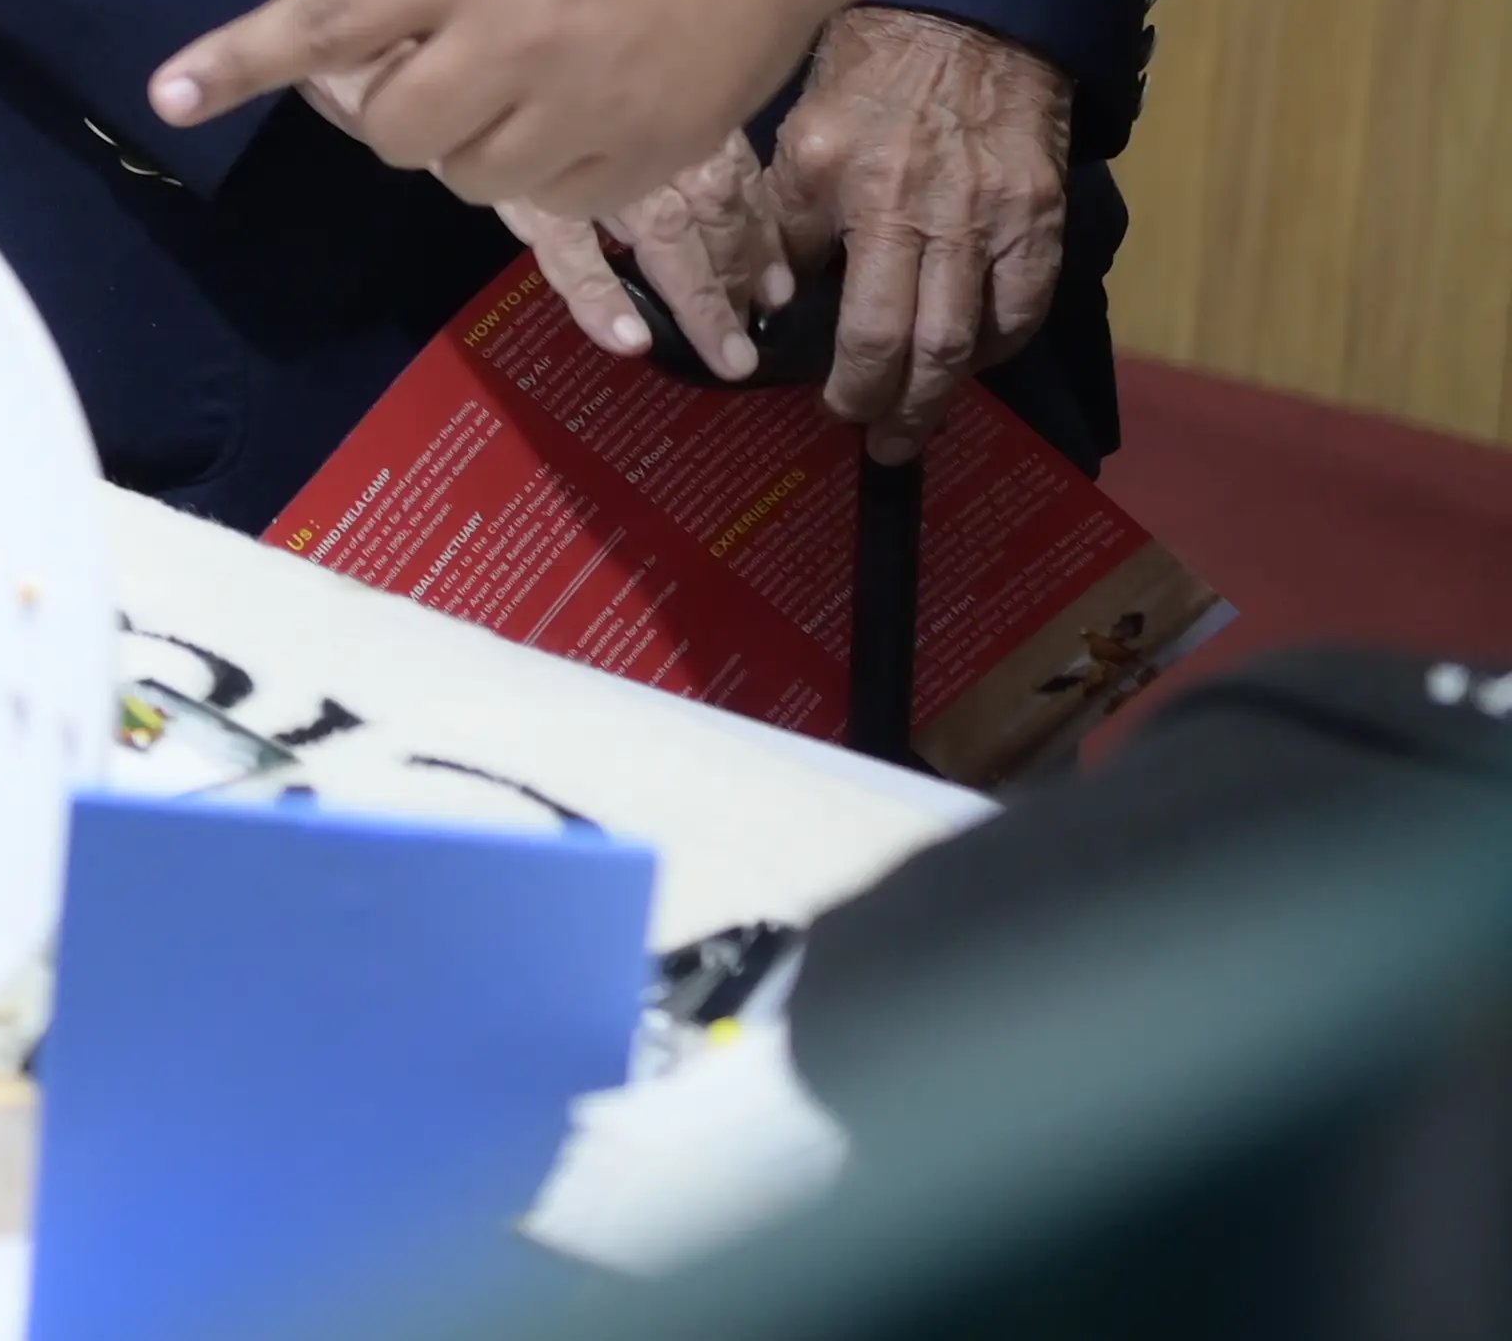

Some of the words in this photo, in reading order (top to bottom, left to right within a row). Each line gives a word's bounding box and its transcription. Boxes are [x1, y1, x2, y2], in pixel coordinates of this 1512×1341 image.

[463, 309, 502, 348] HOW
[496, 289, 522, 314] TO
[515, 370, 538, 393] By
[531, 353, 554, 375] Air
[565, 412, 587, 435] By
[580, 384, 614, 417] Train
[346, 535, 361, 550] of
[354, 516, 378, 542] great
[371, 494, 396, 521] pride
[388, 479, 408, 499] and
[401, 448, 435, 485] prestige
[427, 435, 444, 452] for
[438, 421, 456, 440] the
[361, 534, 383, 558] from
[379, 522, 393, 536] as
[388, 508, 405, 526] far
[419, 475, 433, 488] as
[428, 424, 475, 477] Maharashtra
[471, 407, 490, 427] and
[624, 463, 647, 487] By
[639, 434, 674, 469] Road
[335, 497, 367, 532] MELA
[359, 466, 393, 503] CAMP
[362, 568, 377, 583] by
[372, 552, 389, 571] the
[407, 510, 425, 528] the
[420, 474, 455, 513] numbers
[483, 418, 502, 438] and
[437, 567, 462, 593] refer
[459, 553, 473, 567] to
[470, 536, 487, 554] the
[486, 492, 524, 535] Chambal
[521, 478, 536, 493] as
[533, 460, 551, 479] the
[708, 465, 805, 560] EXPERIENCES
[285, 528, 312, 551] Us
[428, 511, 485, 576] SANCTUARY
[456, 573, 477, 596] from
[473, 558, 490, 576] the
[485, 535, 509, 561] blood
[504, 524, 518, 538] of
[512, 511, 529, 529] the
[482, 596, 499, 614] the
[494, 562, 528, 600] Chambal
[509, 571, 541, 606] remains
[548, 546, 562, 559] of
[575, 605, 614, 649] combining
